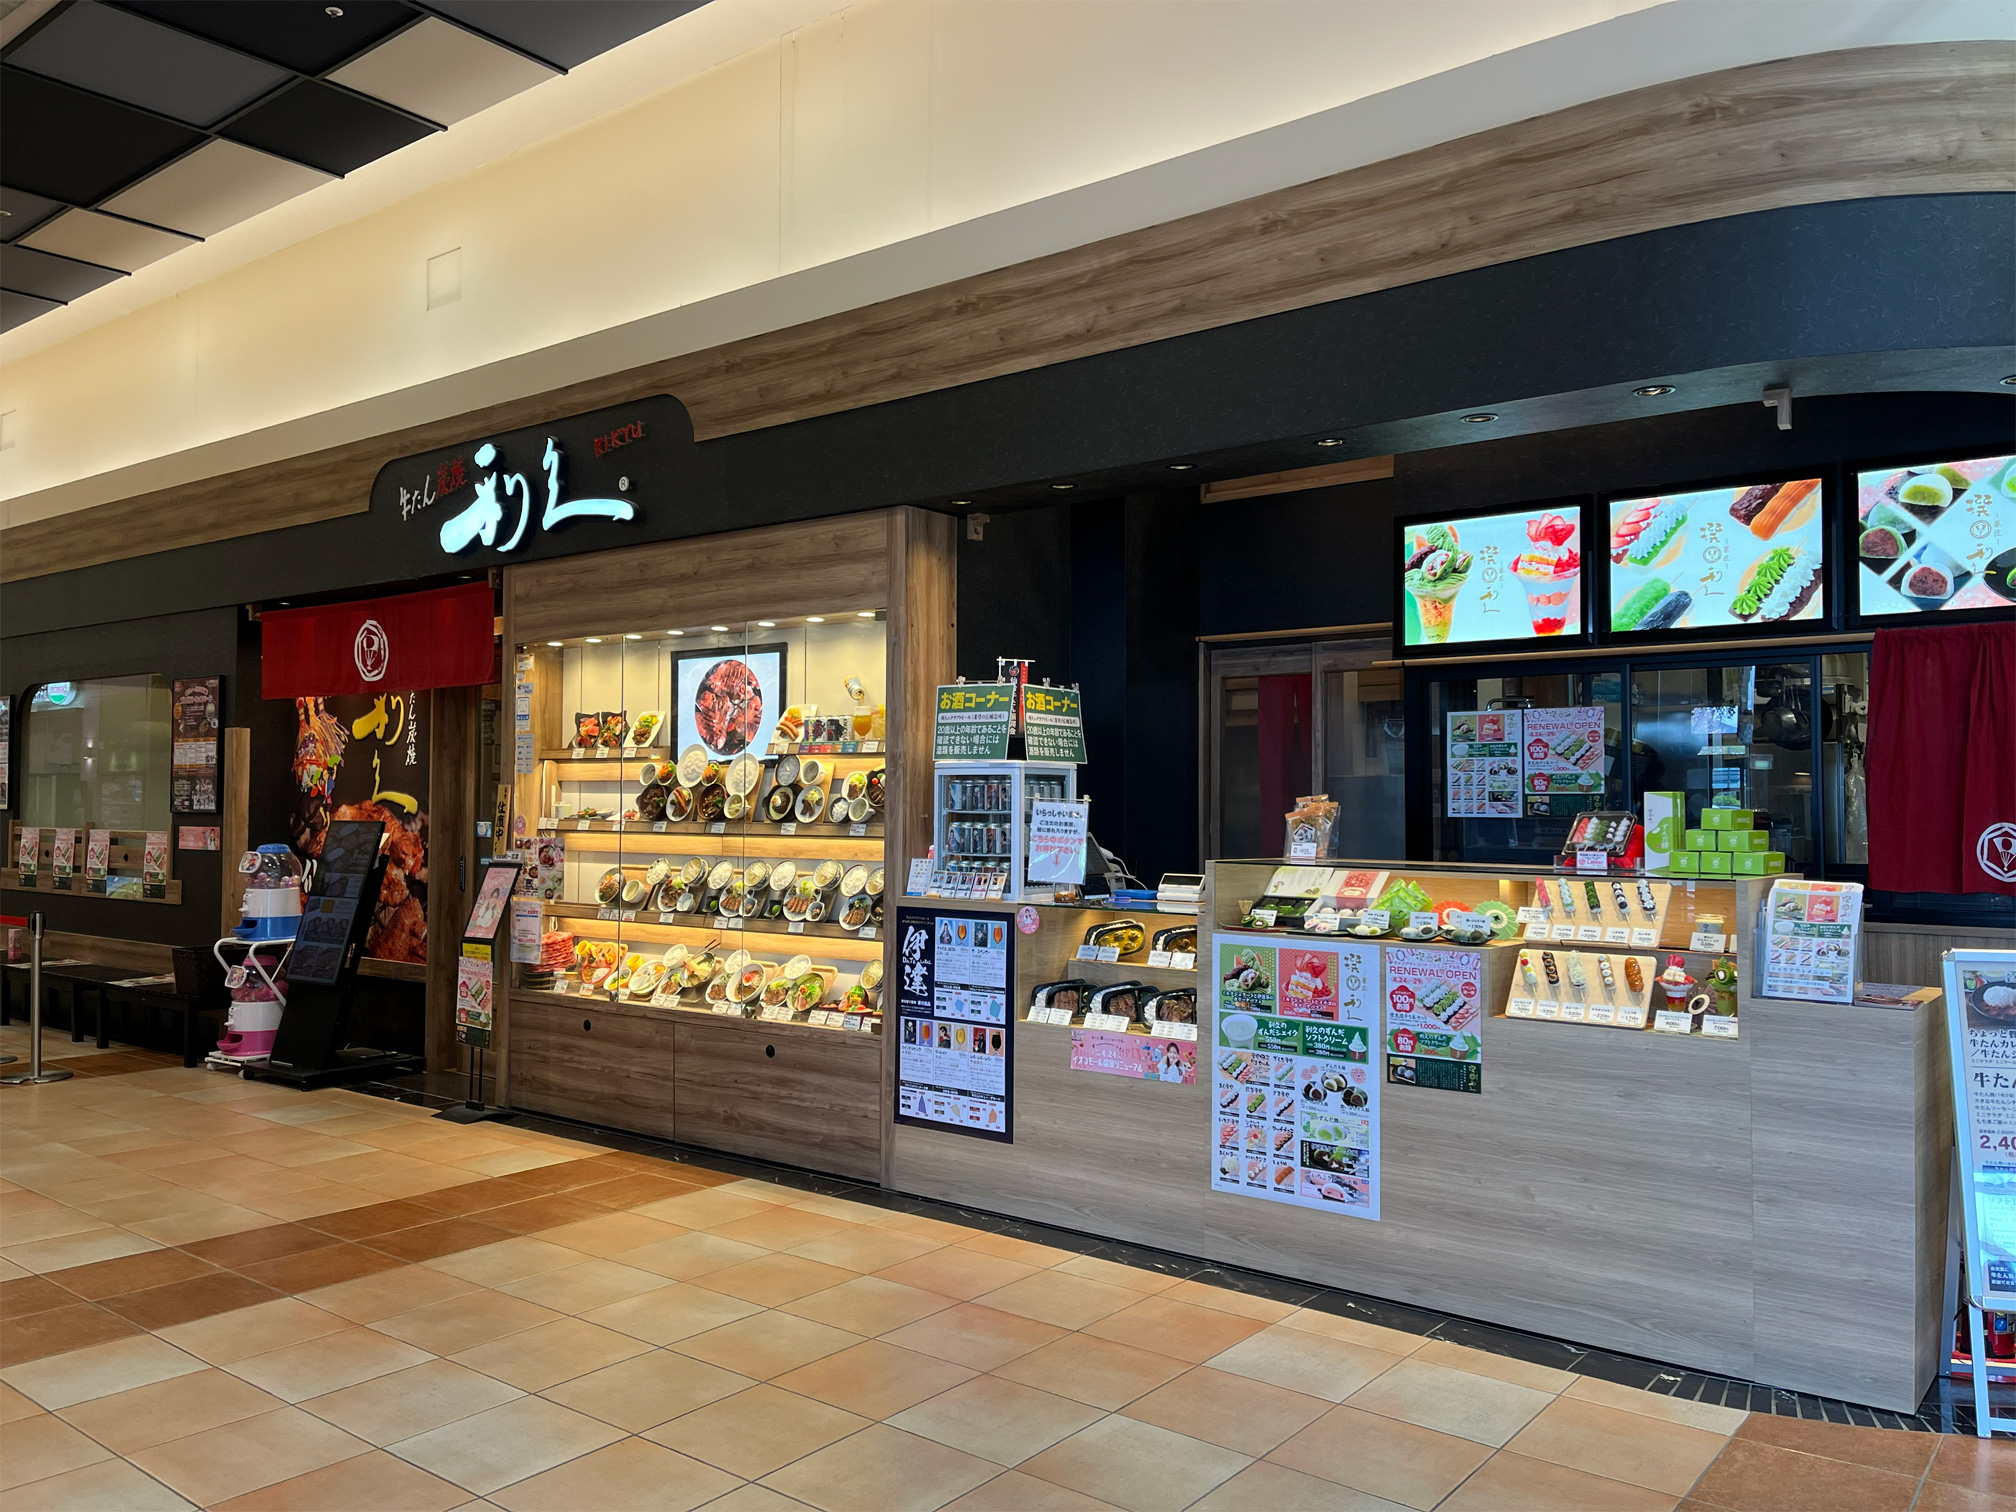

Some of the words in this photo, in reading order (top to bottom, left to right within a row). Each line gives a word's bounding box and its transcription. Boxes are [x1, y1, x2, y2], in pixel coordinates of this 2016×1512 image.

[940, 691, 1010, 710] お酒コーナー
[1026, 691, 1078, 713] お酒コーナー
[1527, 722, 1571, 730] RENEWAL
[1574, 721, 1601, 729] OPEN
[936, 735, 999, 745] 確認できない場合には
[1027, 736, 1079, 748] 確認できない場合には
[936, 746, 991, 755] 酒類を販売しません
[1028, 747, 1075, 758] 酒類を販売しません
[1031, 835, 1084, 845] こちらのボタンで
[1389, 966, 1443, 978] RENEWAL
[1446, 970, 1477, 980] OPEN
[1771, 966, 1831, 975] テイクアウトメニュー
[1392, 994, 1414, 1004] 100円
[1268, 1021, 1287, 1029] 利久の
[1258, 1028, 1298, 1037] ずんだシェイク
[1305, 1025, 1345, 1037] 利久のずんだ
[1305, 1034, 1348, 1045] ソフトクリーム
[1397, 1037, 1413, 1045] 80円
[1313, 1042, 1330, 1050] 380円
